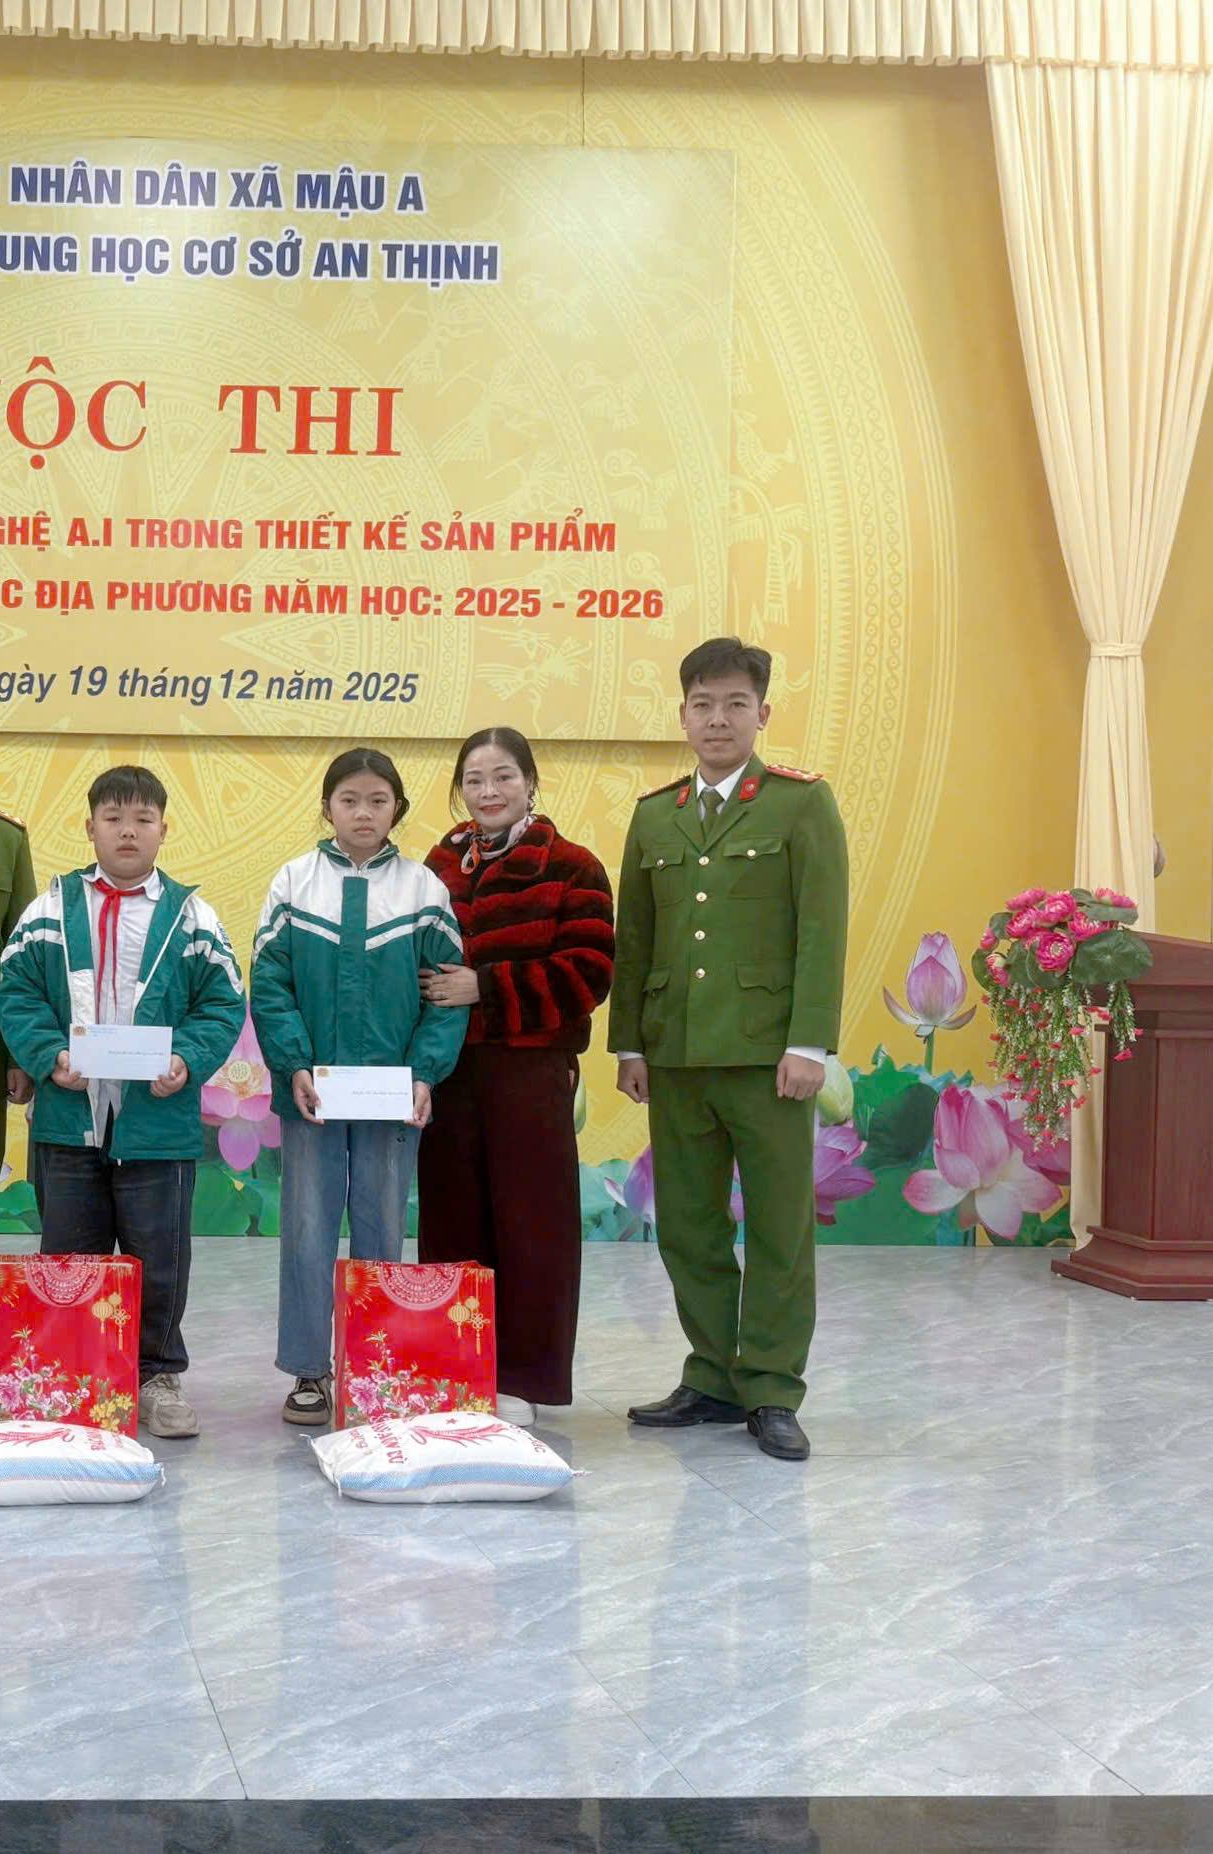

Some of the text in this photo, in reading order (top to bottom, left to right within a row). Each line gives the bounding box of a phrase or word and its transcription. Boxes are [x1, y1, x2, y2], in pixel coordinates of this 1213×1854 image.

[10, 158, 121, 206] NHÂN
[135, 162, 217, 208] DÂN
[229, 164, 284, 210] XÃ
[295, 165, 385, 217] MẬU
[396, 175, 425, 212] A
[91, 236, 170, 282] HỌC
[183, 235, 238, 277] CƠ
[248, 228, 303, 278] SỞ
[312, 241, 370, 279] AN
[380, 243, 499, 289] THỊNH
[218, 383, 403, 457] THI
[67, 517, 113, 547] A.I
[126, 518, 244, 550] TRONG
[256, 510, 351, 550] THIẾT
[363, 510, 411, 551] KẾ
[420, 511, 495, 552] SẢN
[509, 505, 617, 553] PHẨM
[34, 579, 95, 614] ĐỊA
[106, 580, 253, 614] PHƯƠNG
[263, 576, 349, 615] NĂM
[360, 584, 443, 621] HỌC:
[454, 586, 542, 619] 2025
[577, 588, 665, 619] 2026
[69, 665, 108, 696] 19
[118, 667, 212, 706] tháng
[219, 669, 259, 699] 12
[265, 669, 334, 700] năm
[342, 671, 420, 702] 2025
